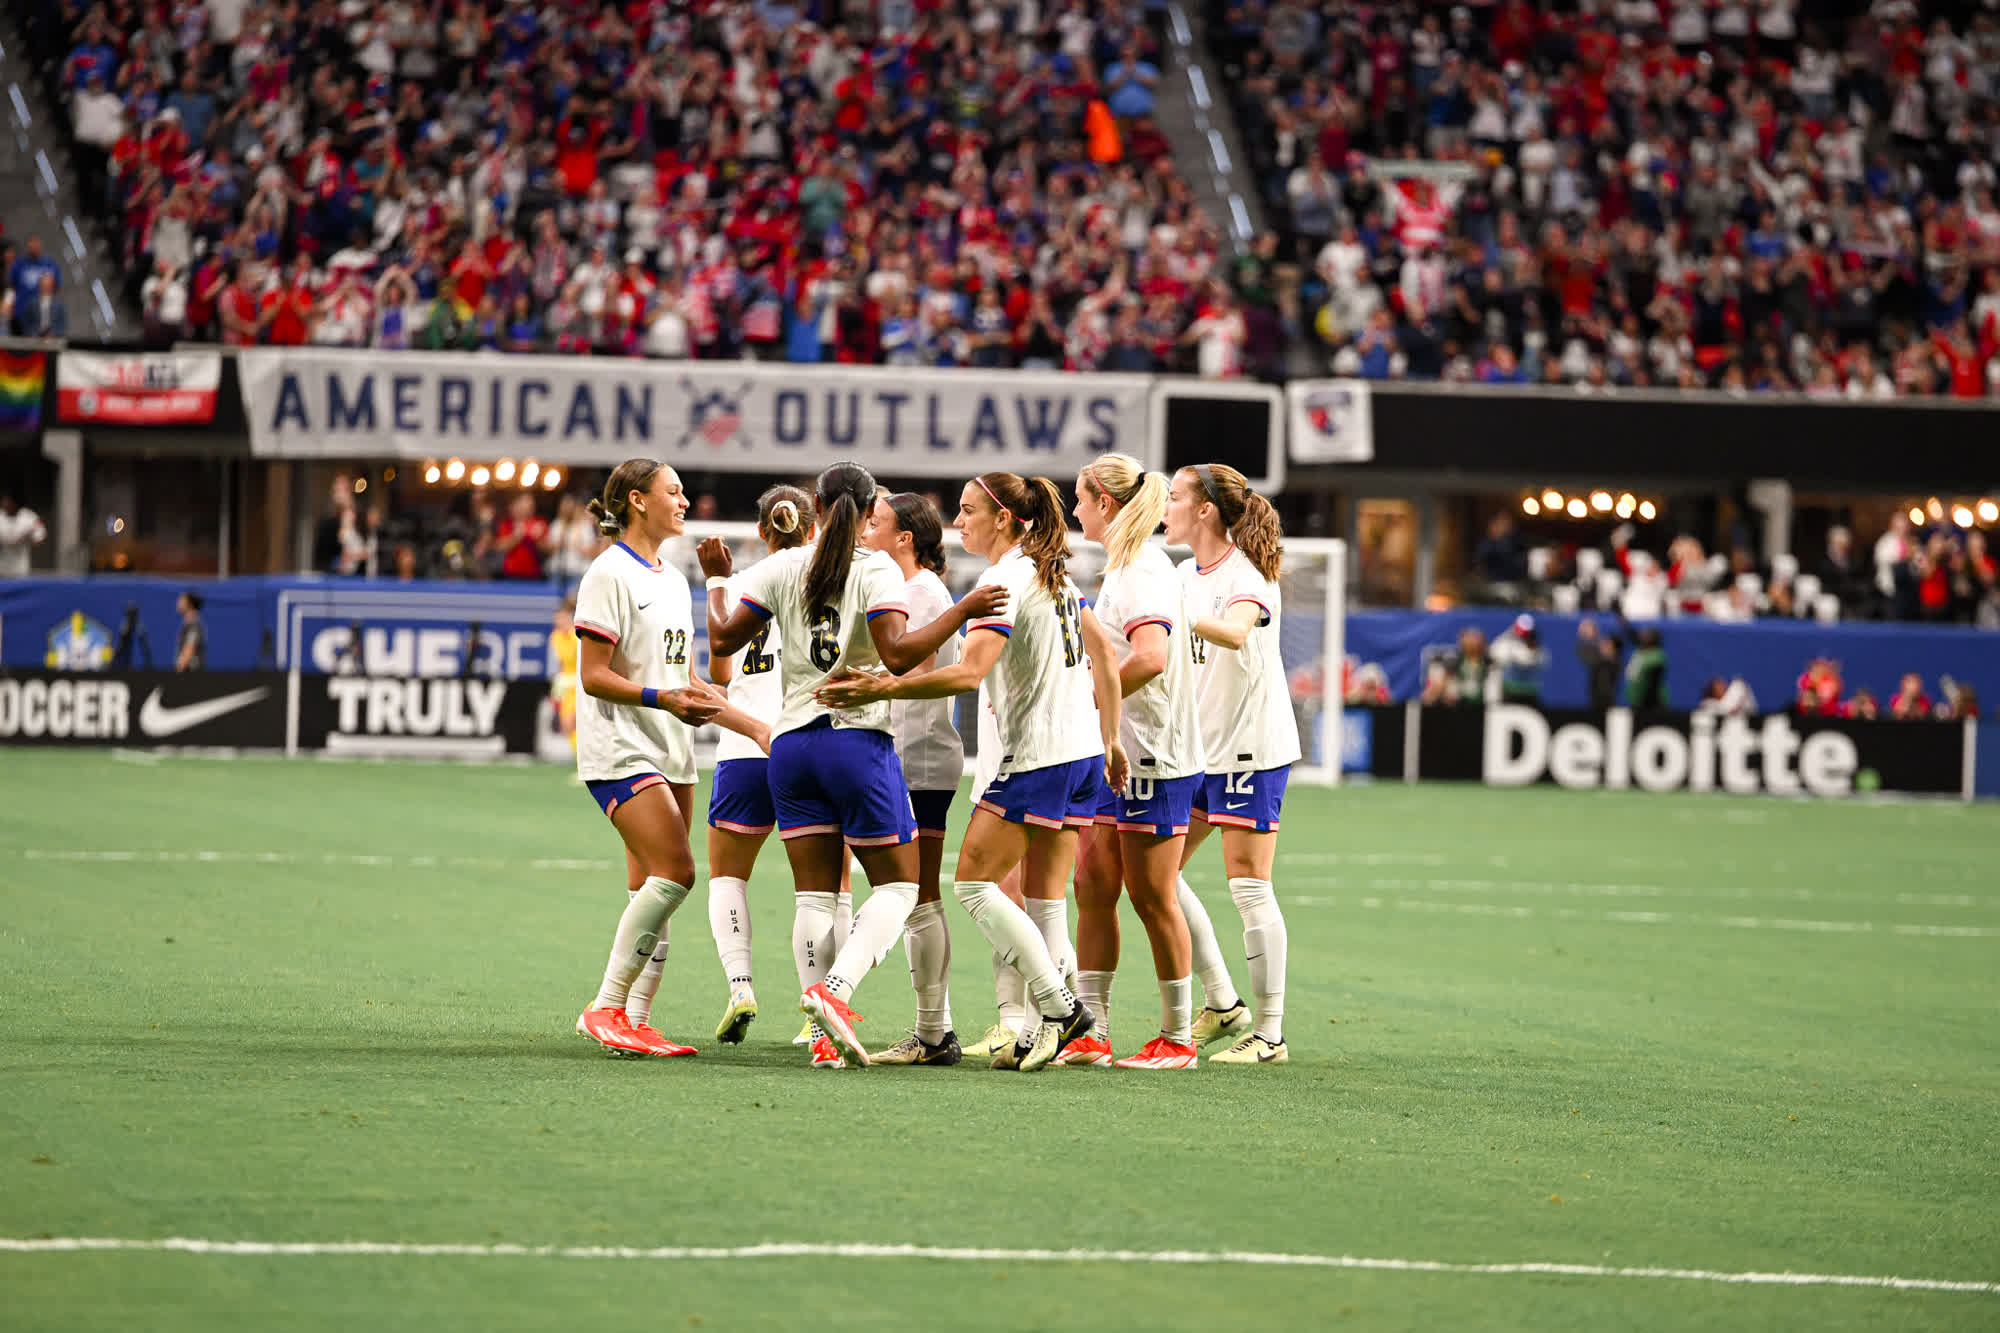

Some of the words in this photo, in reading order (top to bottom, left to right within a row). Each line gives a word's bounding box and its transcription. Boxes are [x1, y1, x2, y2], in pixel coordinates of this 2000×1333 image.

[271, 372, 652, 441] AMERICAN
[773, 390, 1118, 452] OUTLAWS
[663, 628, 687, 665] 22
[809, 604, 842, 674] 8
[1053, 591, 1084, 668] 13
[327, 675, 507, 736] TRULY
[730, 909, 740, 933] USA
[806, 940, 816, 968] USA
